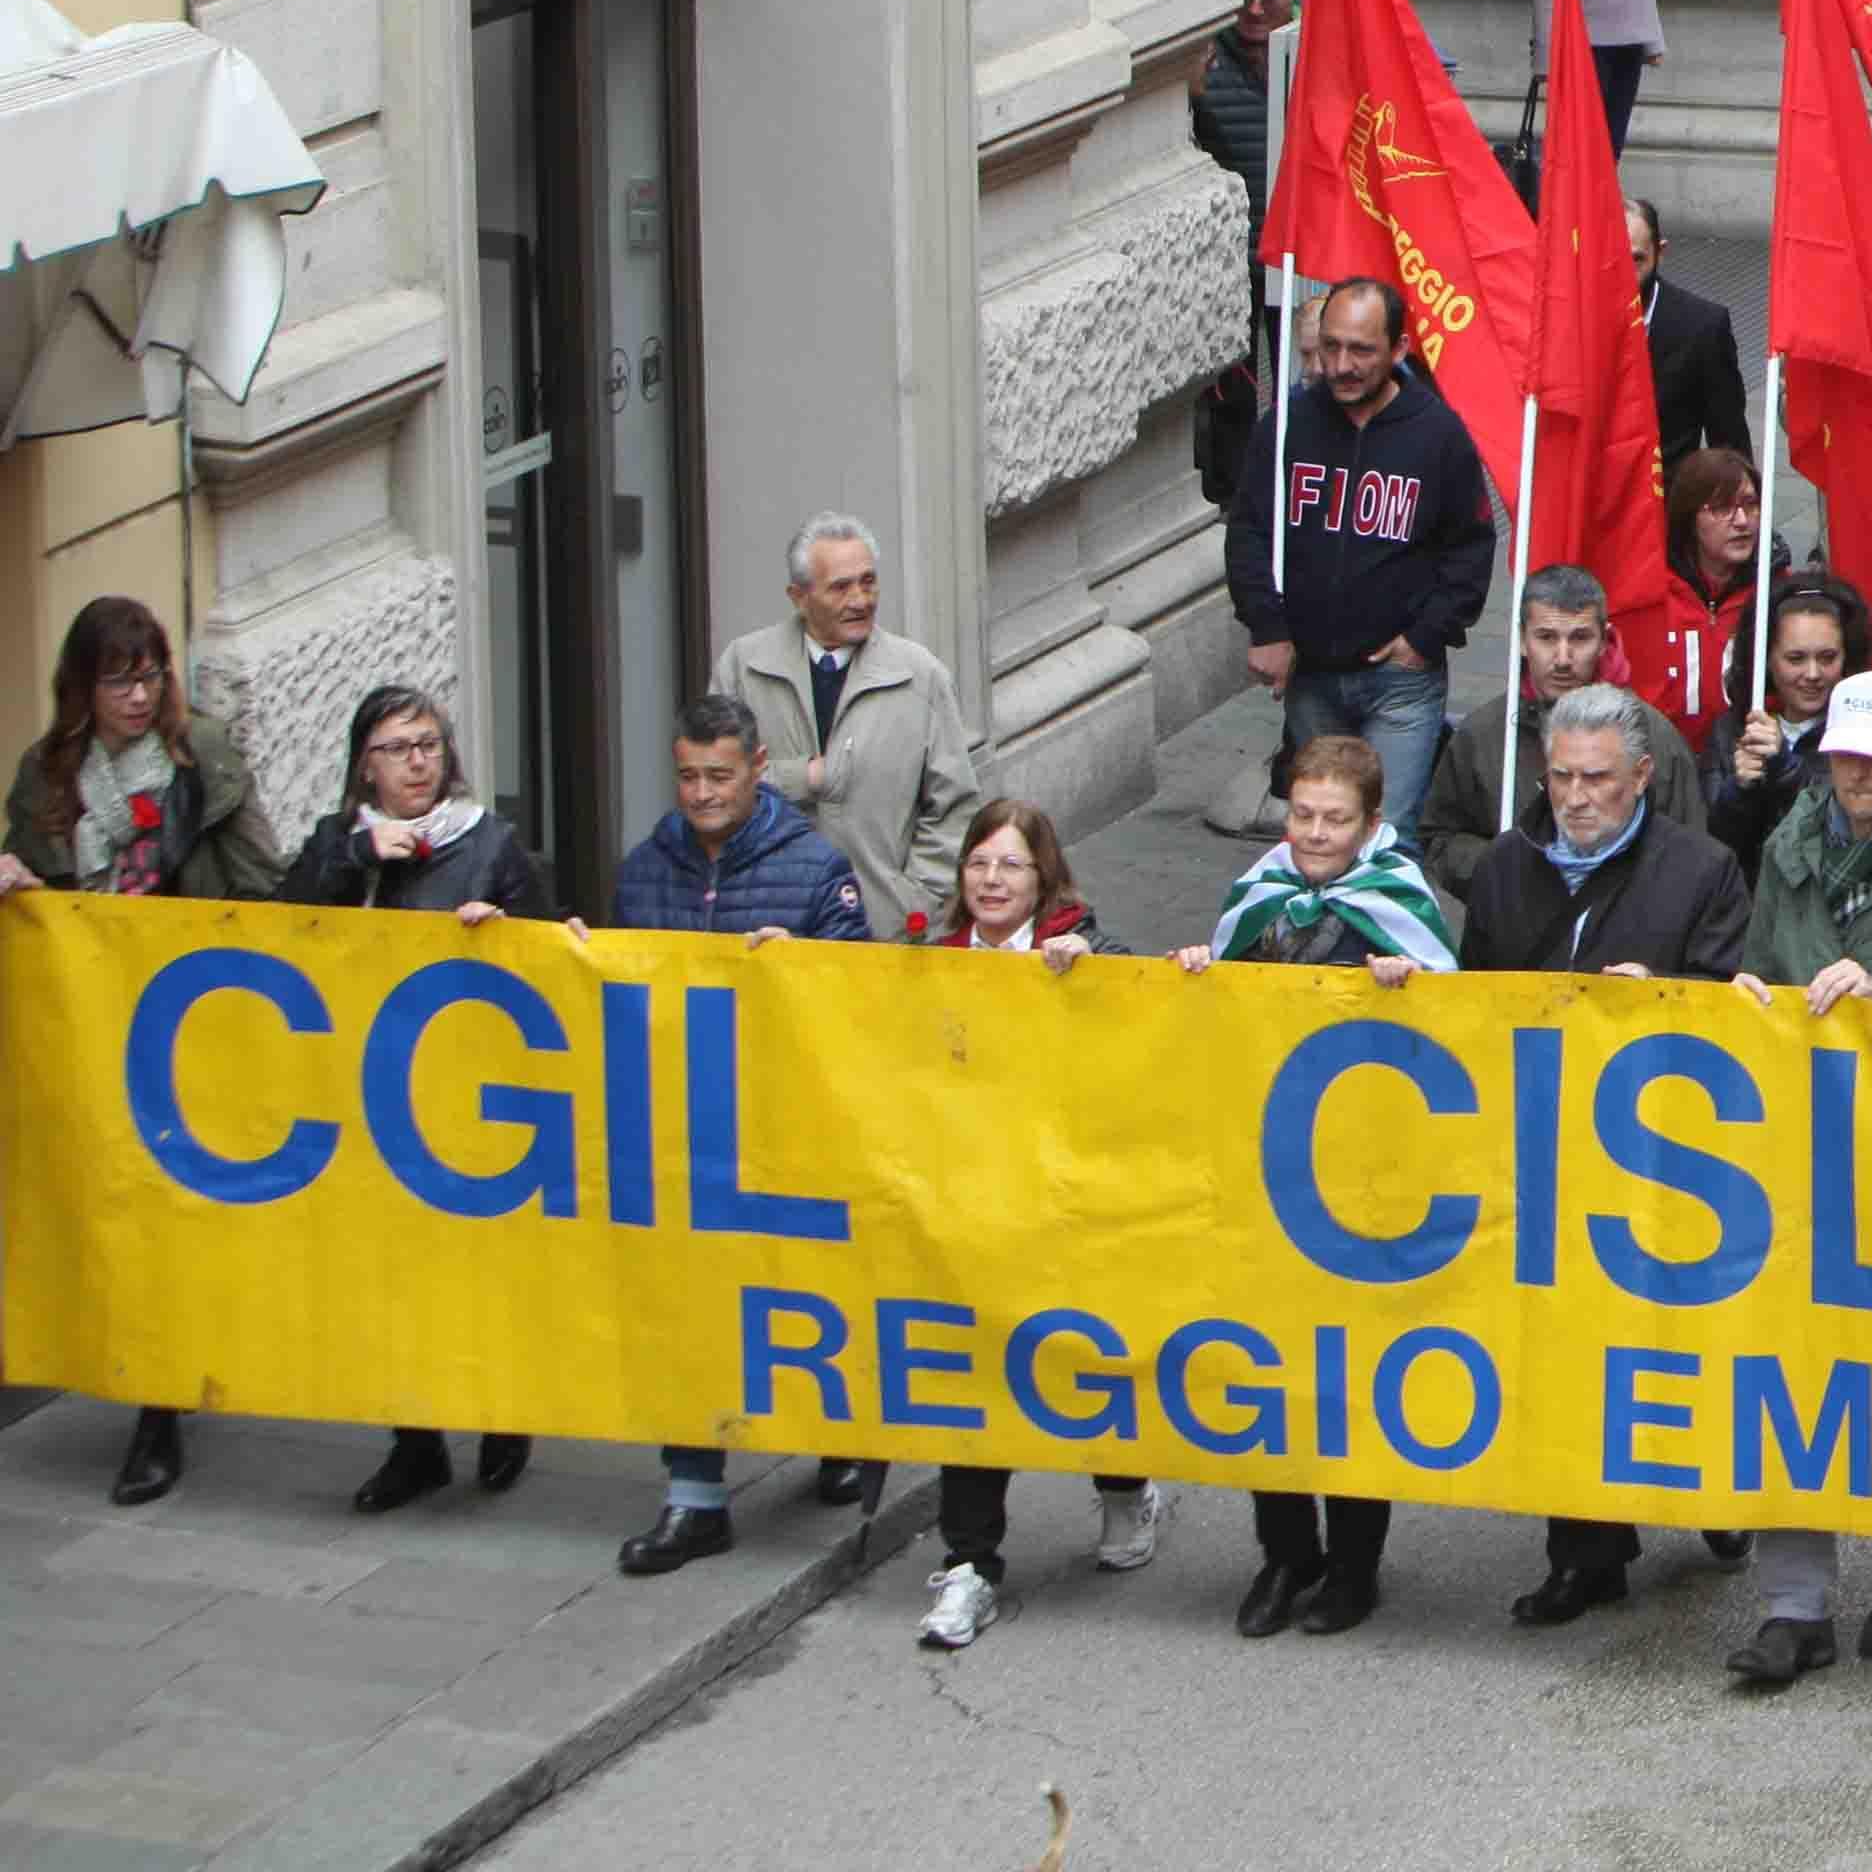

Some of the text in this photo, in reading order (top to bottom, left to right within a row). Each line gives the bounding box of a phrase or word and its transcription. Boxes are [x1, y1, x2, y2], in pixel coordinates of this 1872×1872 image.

[1290, 462, 1421, 542] FIOM
[122, 947, 851, 1242] CGIL
[741, 1285, 1502, 1470] REGGIO
